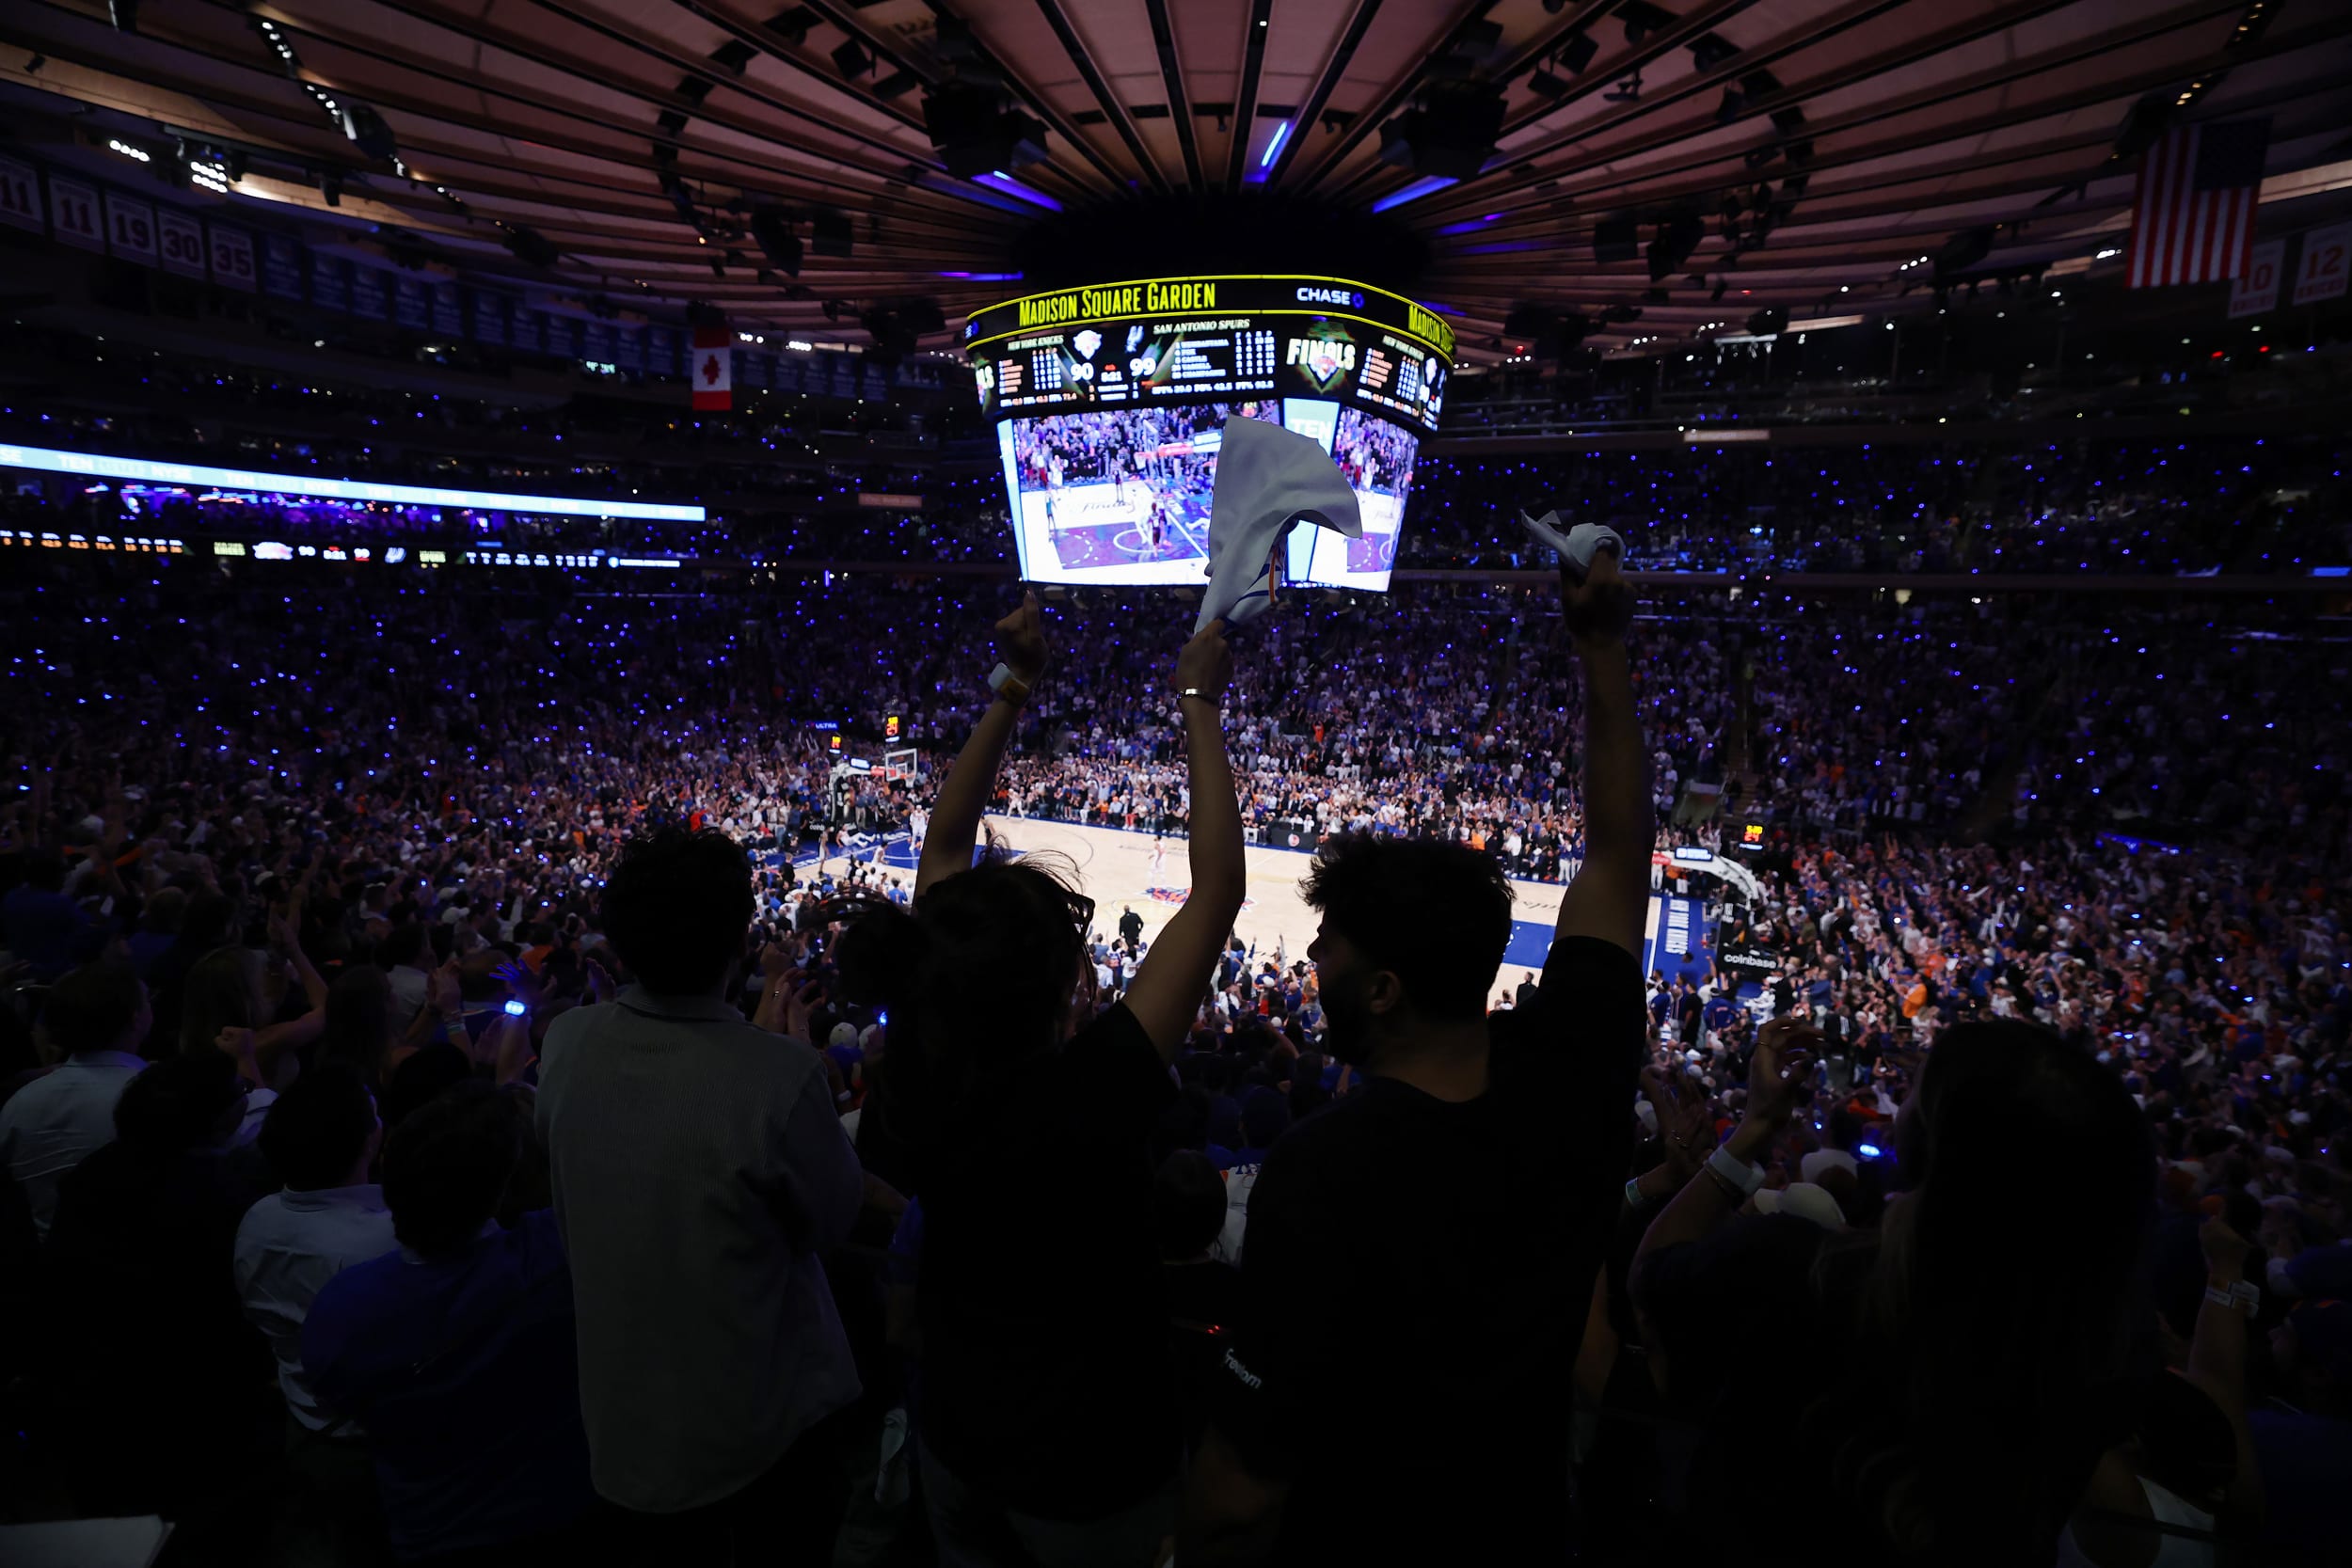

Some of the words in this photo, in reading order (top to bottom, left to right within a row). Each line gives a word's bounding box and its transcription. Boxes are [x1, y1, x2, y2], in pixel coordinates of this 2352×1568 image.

[1, 175, 33, 215] 11
[61, 198, 94, 235] 11
[117, 213, 150, 250] 19
[164, 229, 200, 264] 30
[215, 244, 251, 277] 35
[2308, 245, 2344, 279] 12
[1019, 293, 1078, 327] MADISON
[1082, 288, 1142, 318] SQUARE
[1147, 282, 1216, 311] GARDEN
[1296, 287, 1351, 306] CHASE
[1152, 323, 1173, 335] SAN
[1173, 320, 1216, 333] ANTONIO
[1218, 319, 1251, 331] SPURS
[1408, 304, 1440, 345] MADISON
[1129, 357, 1157, 377] 99
[1286, 338, 1356, 372] FINALS
[1070, 362, 1095, 382] 90
[1290, 419, 1333, 441] TEN
[57, 453, 94, 471] TEN
[151, 464, 193, 481] NYSE
[225, 471, 255, 487] TEN
[303, 480, 340, 494] NYSE
[1724, 954, 1777, 969] coinbase
